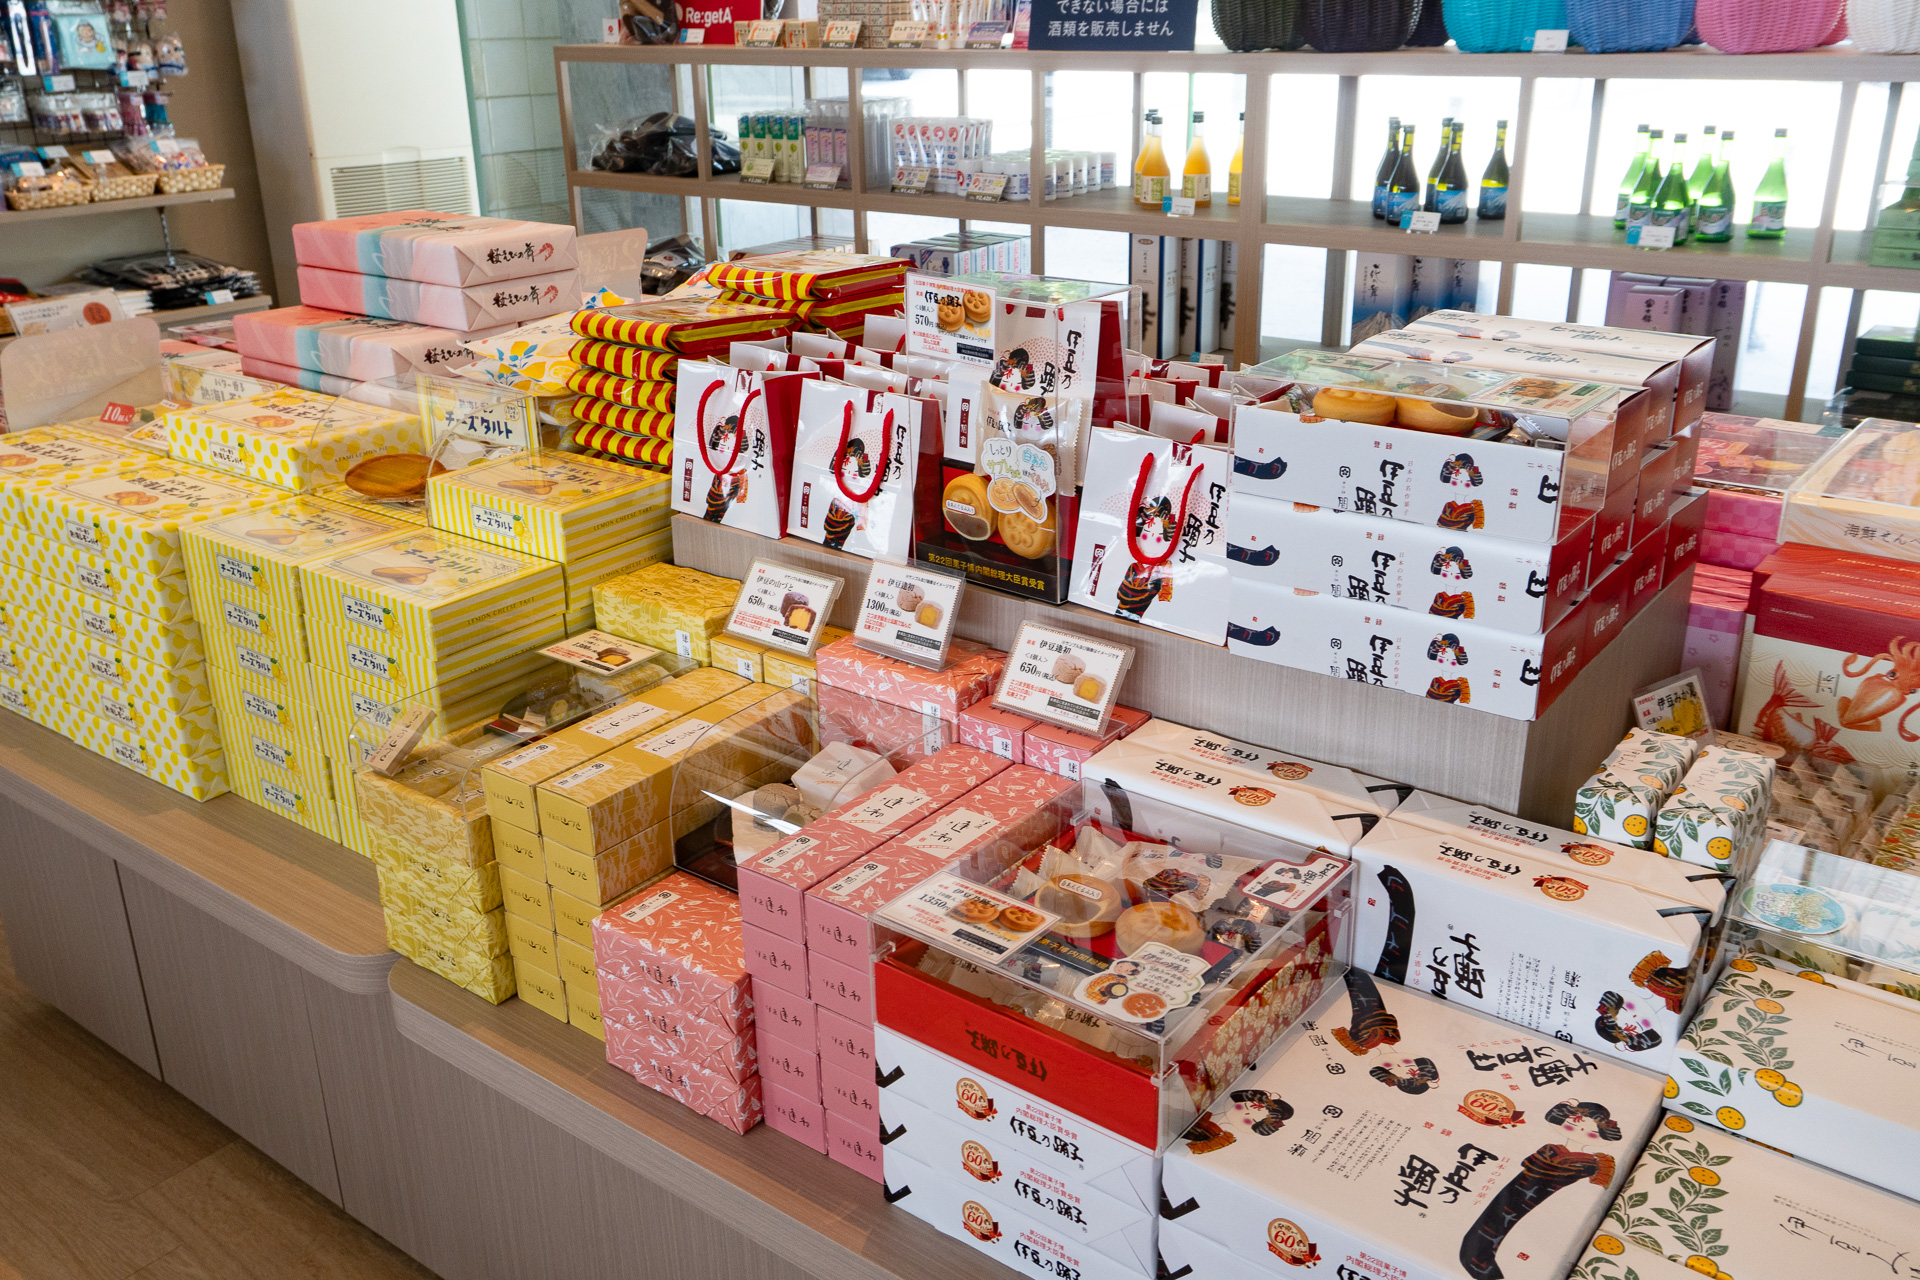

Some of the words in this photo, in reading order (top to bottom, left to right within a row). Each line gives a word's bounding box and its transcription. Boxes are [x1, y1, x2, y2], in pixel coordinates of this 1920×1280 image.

[685, 6, 732, 28] Re:getA
[1059, 0, 1168, 14] できない場合には
[1048, 20, 1174, 37] 酒類を販売しません
[444, 410, 513, 439] チーズタルト
[989, 443, 1012, 458] しっとり
[475, 514, 513, 533] チーズタルト
[593, 521, 614, 531] LEMON
[637, 506, 653, 518] TART
[1204, 482, 1227, 546] 伊豆乃
[220, 562, 253, 582] チーズタルト
[927, 552, 1045, 591] 第22回菓子博内閣総理大臣賞受賞
[756, 574, 795, 592] 伊豆の山づと
[887, 577, 915, 592] 伊豆逢初
[227, 610, 259, 630] チーズタルト
[346, 604, 383, 626] チーズタルト
[1039, 639, 1072, 655] 伊豆逢初
[240, 654, 271, 674] チーズタルト
[351, 653, 388, 675] チーズタルト
[1019, 661, 1041, 677] 650円
[246, 700, 278, 719] チーズタルト
[255, 745, 285, 765] チーズタルト
[264, 788, 295, 809] チーズタルト
[1009, 1115, 1084, 1163] 伊豆乃踊子
[1393, 1154, 1440, 1209] 踊子
[1437, 1143, 1499, 1204] 伊豆乃
[1014, 1178, 1088, 1227] 伊豆乃踊子
